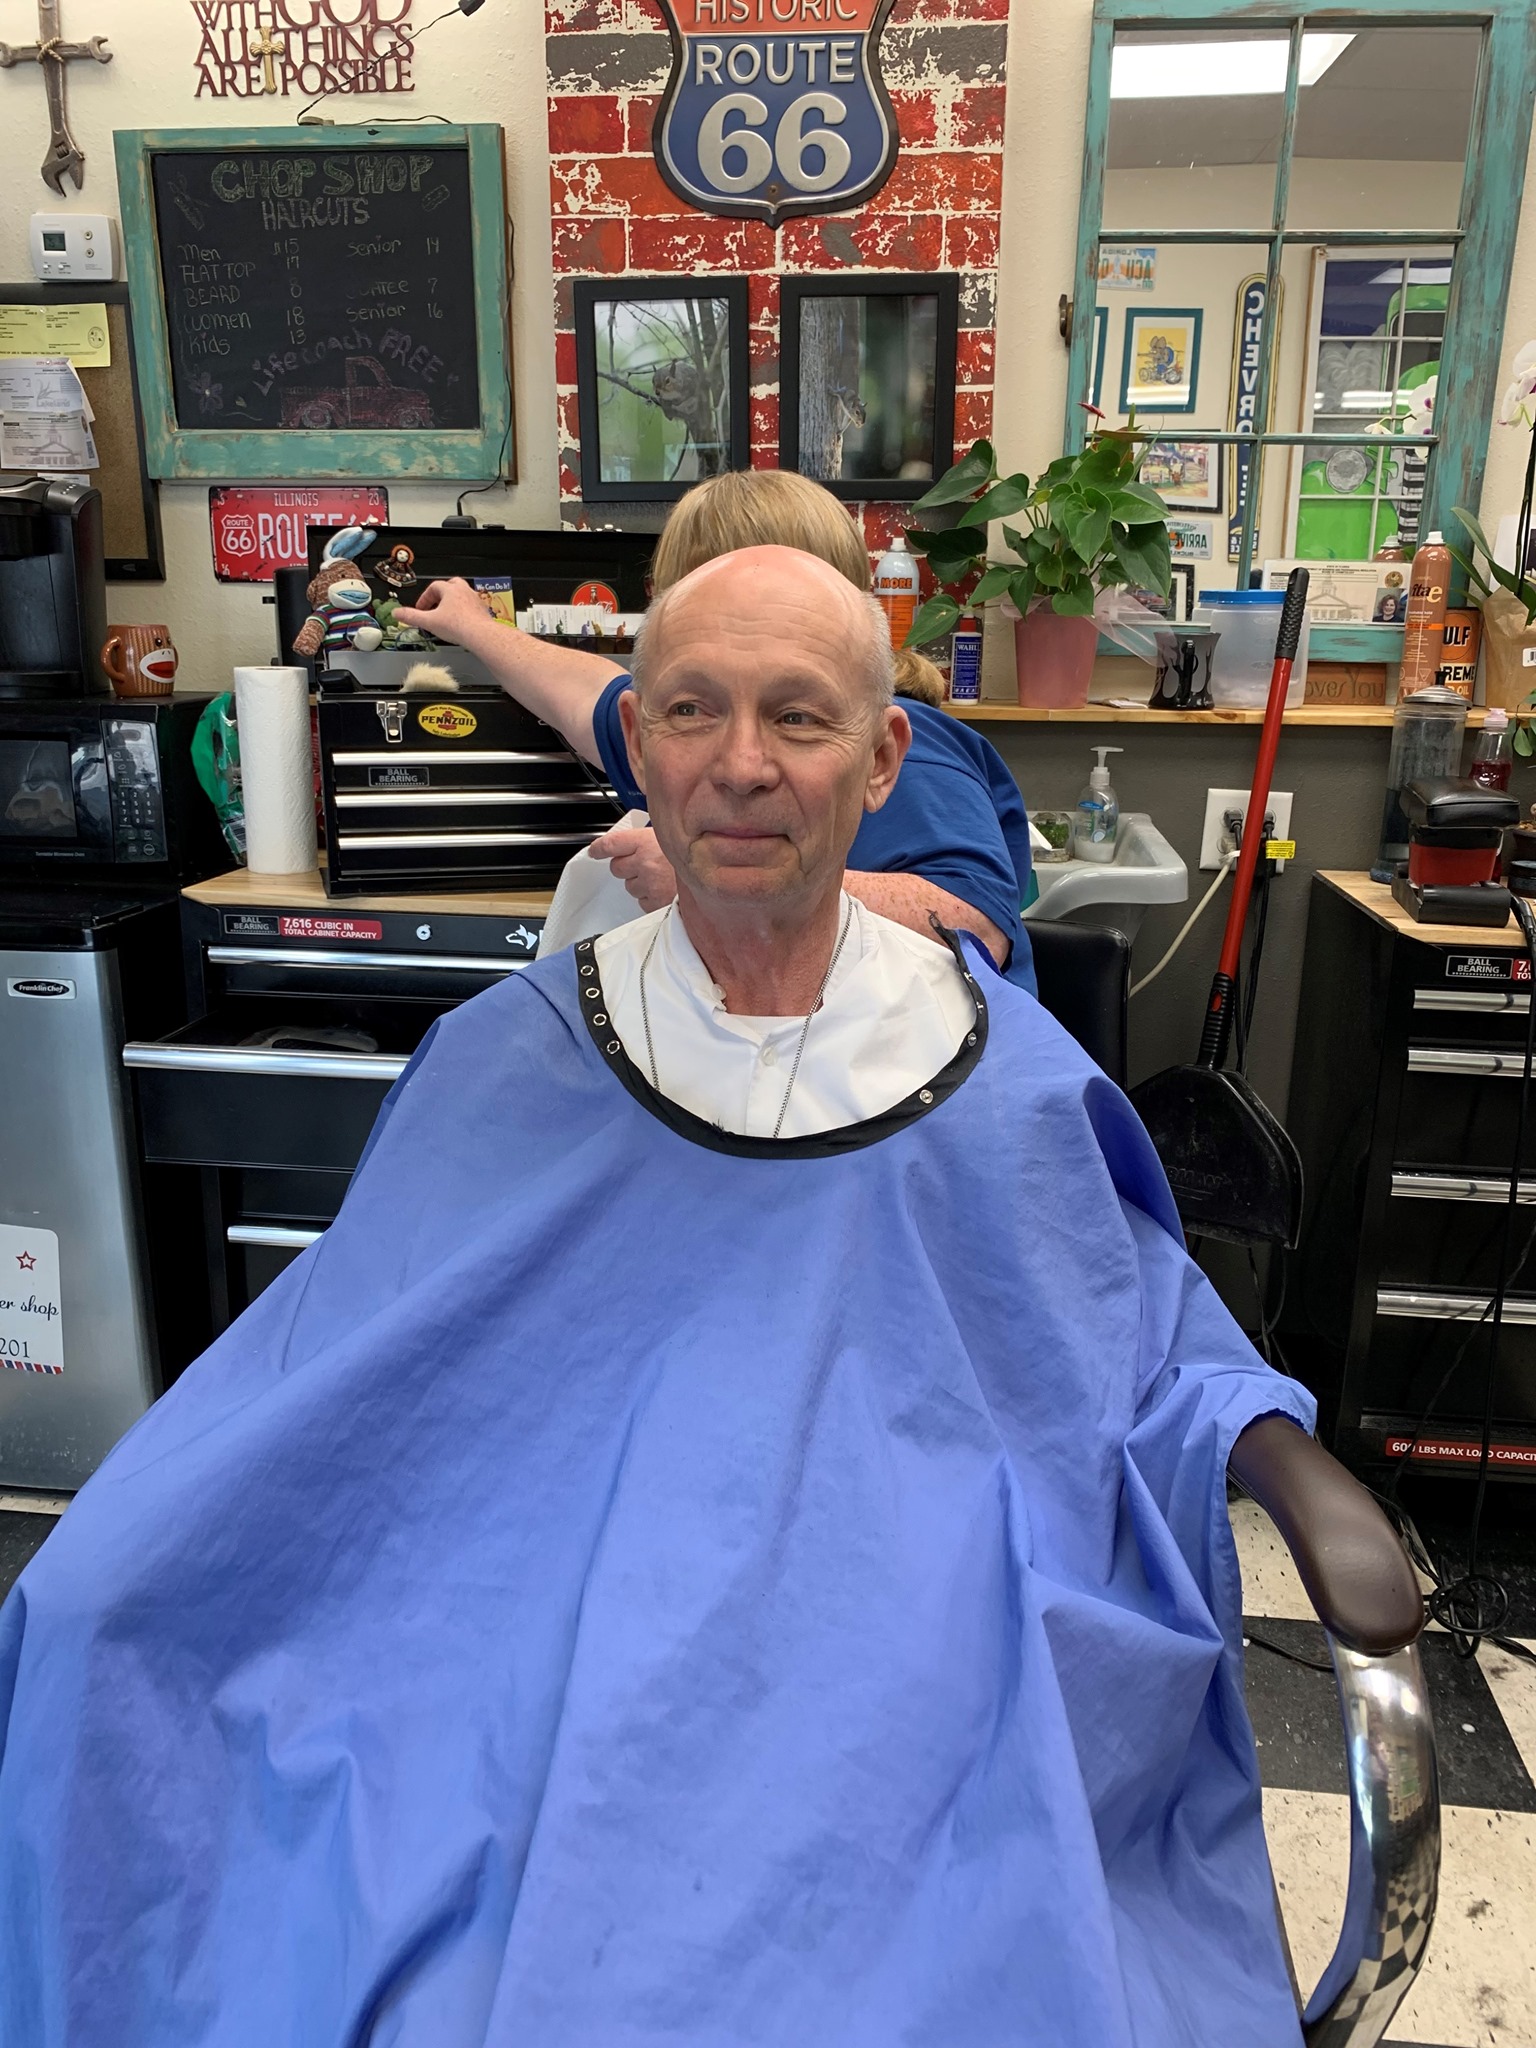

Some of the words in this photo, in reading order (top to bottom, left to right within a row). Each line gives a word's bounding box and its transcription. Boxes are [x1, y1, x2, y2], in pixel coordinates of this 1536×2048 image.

[189, 0, 276, 30] WITH
[695, 0, 857, 23] HISTORIC
[193, 28, 262, 66] ALL
[272, 23, 414, 63] THINGS
[695, 41, 856, 85] ROUTE
[194, 62, 264, 97] ARE
[279, 58, 415, 95] POSSIBLE
[697, 92, 852, 193] 66
[211, 158, 316, 202] CHOP
[323, 155, 434, 194] SHOP
[261, 197, 370, 230] HAIRCUTS
[178, 244, 221, 262] Men
[426, 237, 440, 254] 14
[179, 263, 220, 283] FLAT
[226, 262, 256, 279] TOP
[184, 285, 241, 308] BEARD
[427, 277, 438, 294] 7
[287, 306, 305, 327] 18
[427, 302, 443, 319] 16
[189, 332, 231, 356] Kids
[289, 330, 307, 345] 13
[379, 328, 445, 384] FREE
[273, 492, 319, 507] ILLINOIS
[368, 492, 380, 506] 23
[226, 519, 249, 527] ROUTE
[226, 529, 252, 551] 66
[475, 583, 485, 591] We
[485, 583, 495, 591] Can
[495, 583, 503, 591] Do
[880, 577, 913, 589] MORE
[1344, 667, 1384, 699] You
[1456, 685, 1470, 695] OIL
[421, 715, 476, 727] PENNZOIL
[379, 775, 418, 783] BEARING
[387, 768, 409, 776] BALL
[233, 922, 269, 931] BEARING
[240, 916, 260, 924] BALL
[283, 917, 312, 929] 7,616
[315, 920, 342, 930] CUBIC
[343, 922, 354, 931] IN
[284, 928, 307, 937] TOTAL
[308, 928, 341, 938] CABINET
[341, 929, 377, 940] CAPACITY
[1457, 965, 1500, 974] BEARING
[1467, 958, 1491, 966] BALL
[19, 984, 47, 992] Franklin
[47, 985, 64, 993] Chef
[20, 1295, 60, 1321] shop
[1418, 1445, 1437, 1454] LBS
[1439, 1446, 1464, 1456] MAX
